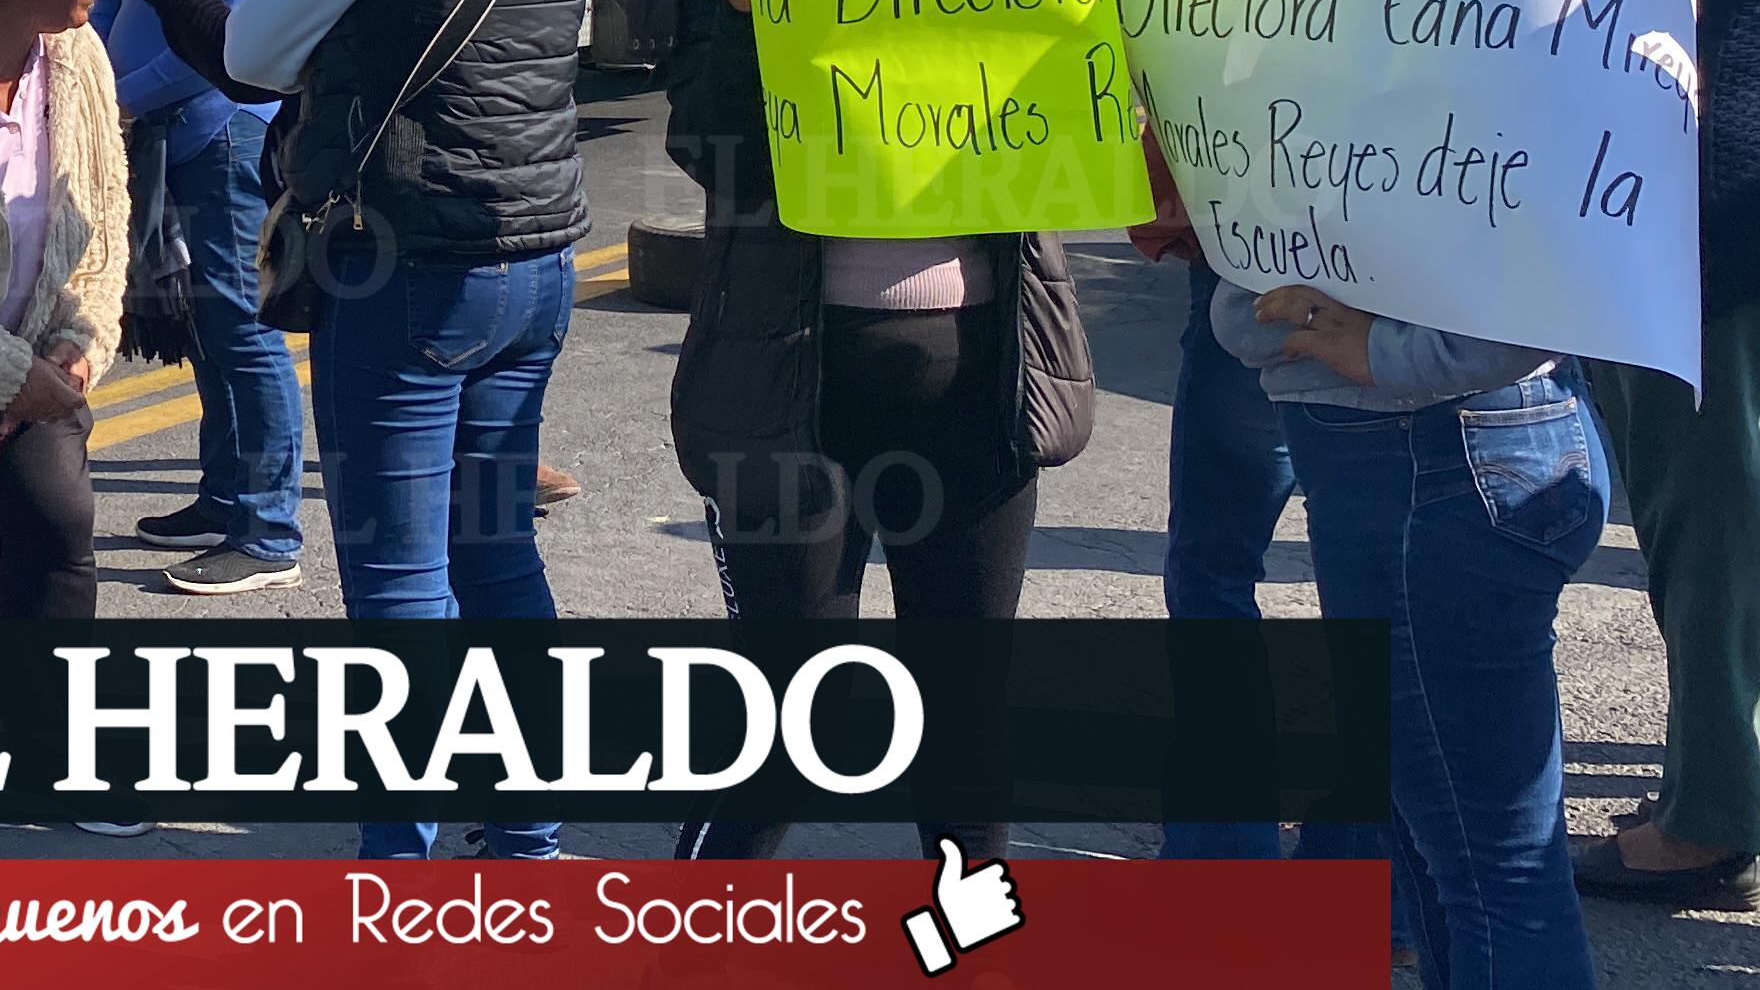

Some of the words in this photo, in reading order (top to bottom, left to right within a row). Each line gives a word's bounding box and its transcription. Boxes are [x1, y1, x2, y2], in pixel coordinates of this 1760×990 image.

[831, 59, 1049, 156] Morales
[1268, 99, 1400, 222] Reyes
[1417, 113, 1530, 228] deje
[1579, 131, 1642, 226] la
[1208, 200, 1375, 284] Escuela.
